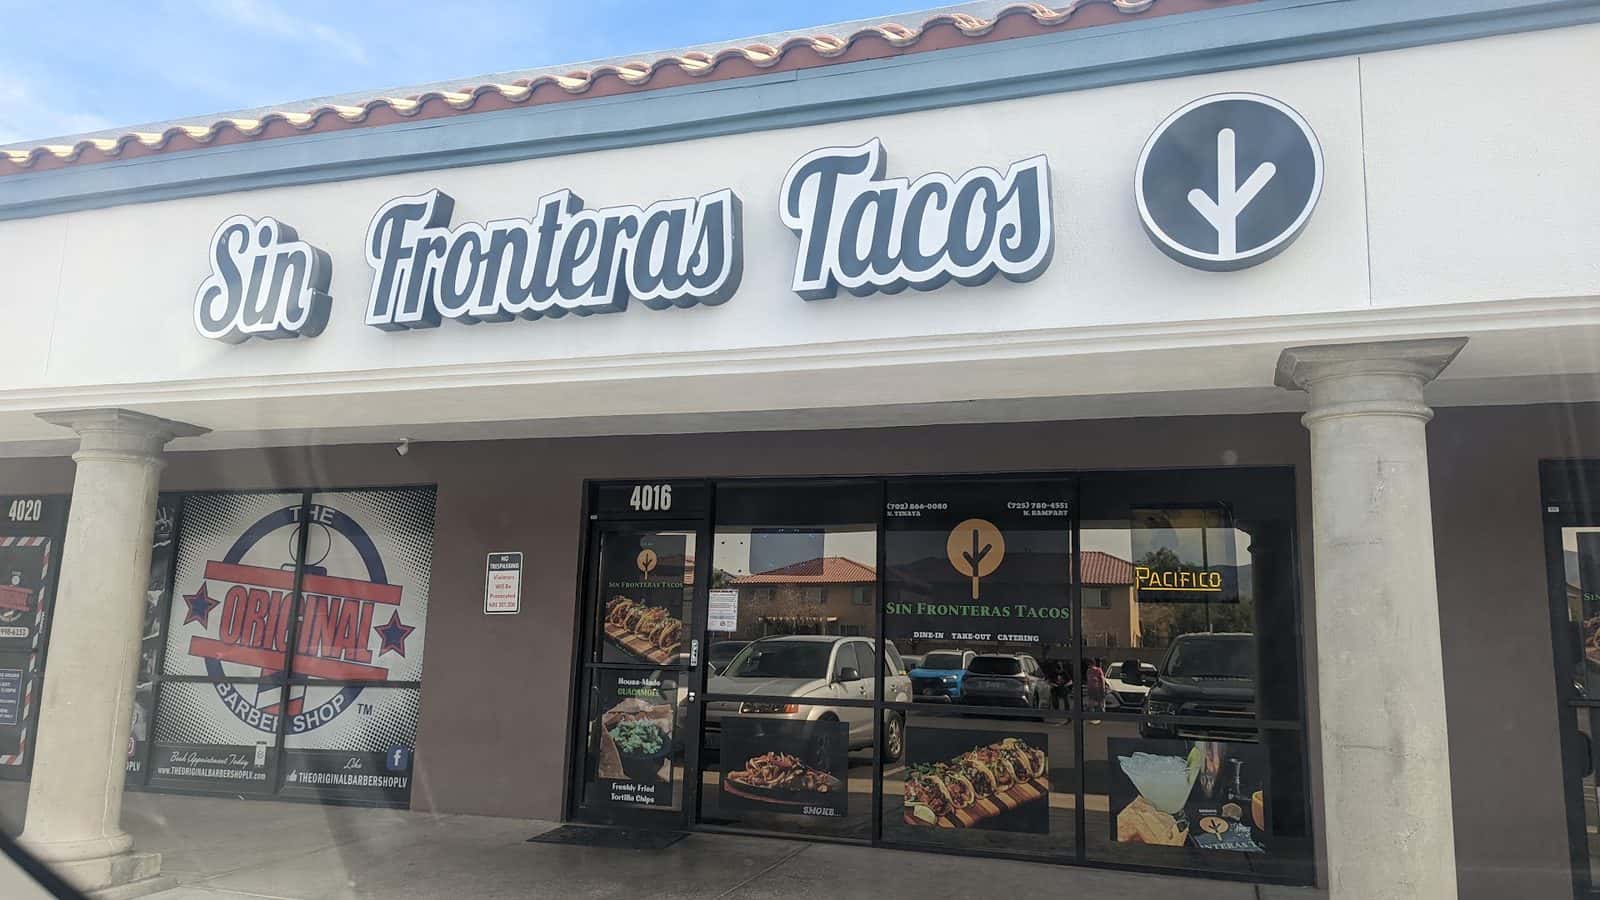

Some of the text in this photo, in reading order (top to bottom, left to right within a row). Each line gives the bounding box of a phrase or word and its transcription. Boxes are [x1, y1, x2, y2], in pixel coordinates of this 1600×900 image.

[194, 138, 1052, 340] Sin Fronteras Tacos
[629, 484, 673, 511] 4016
[886, 502, 909, 511] (702)
[8, 499, 42, 521] 4020
[289, 505, 336, 526] THE
[1032, 509, 1068, 517] RAMPART
[1135, 566, 1222, 590] PACIFICO
[886, 601, 1071, 620] SIN FRONTERAS TACOS
[219, 584, 375, 664] ORIGINAL
[913, 631, 1040, 642] DINE-IN TAKE-OUT CATERING
[293, 694, 345, 733] SHOP
[357, 703, 374, 716] TM
[298, 771, 408, 788] THEORIGINALBARBERSHOPLV
[612, 782, 655, 793] Freshly Fried
[611, 793, 655, 804] Tortilla Chips
